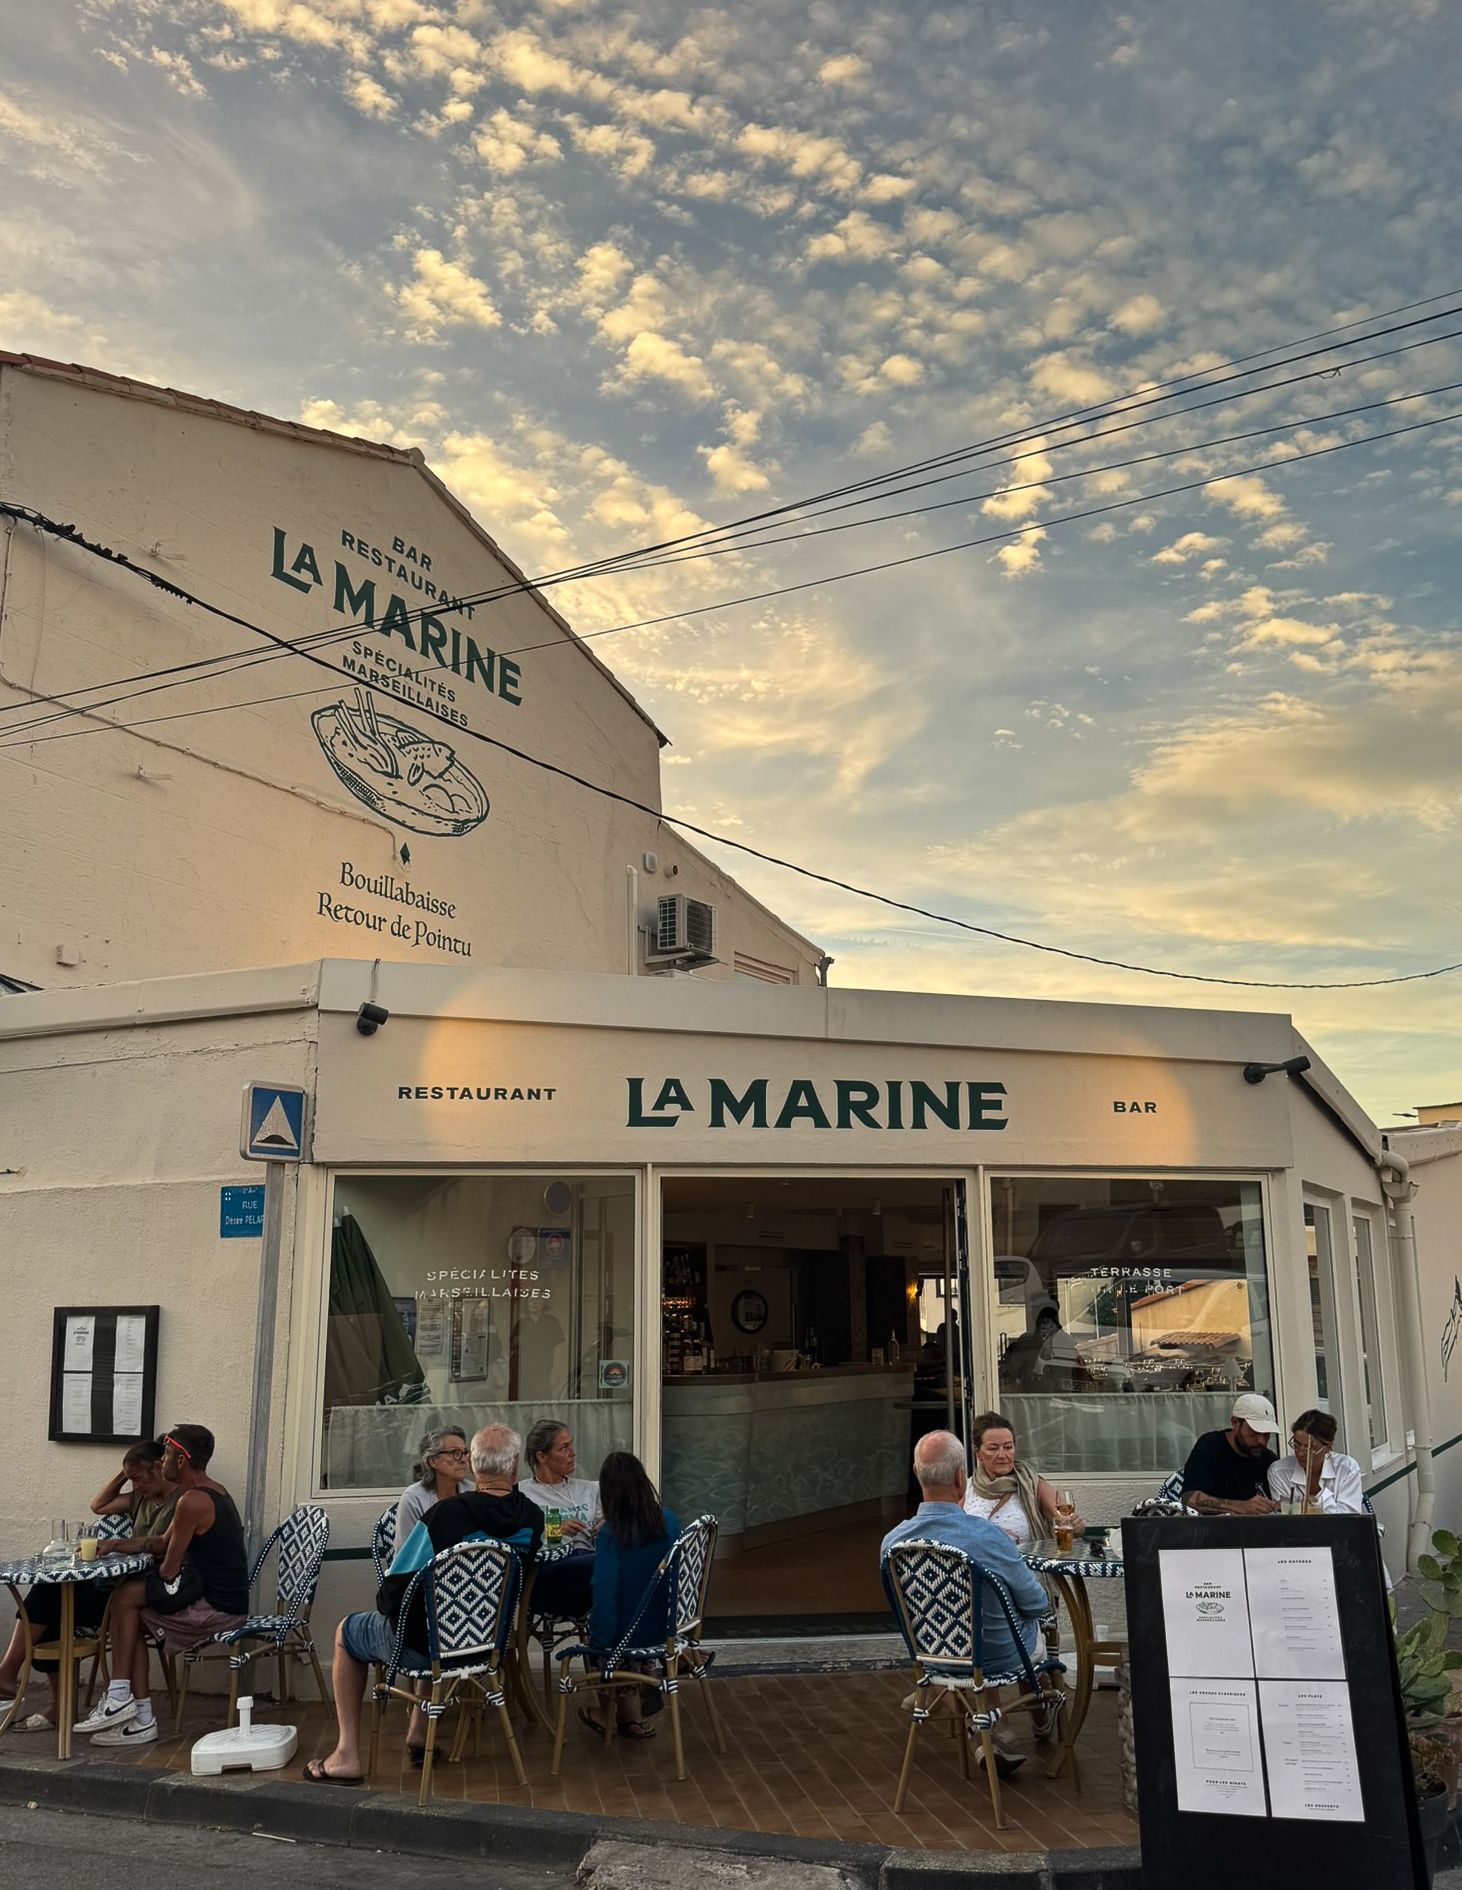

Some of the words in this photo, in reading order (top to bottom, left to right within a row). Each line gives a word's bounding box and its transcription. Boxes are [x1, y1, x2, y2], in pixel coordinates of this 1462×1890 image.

[342, 529, 475, 620] RESTAURANT
[392, 536, 432, 572] BAR
[271, 525, 323, 594] LA
[333, 559, 522, 706] MARINE
[342, 654, 469, 727] MARSEILLAISES
[352, 640, 456, 702] SPÉCIALITÉS
[339, 862, 456, 918] Bouillabaisse
[317, 891, 387, 932] Retour
[390, 914, 412, 940] de
[411, 920, 472, 957] Pointu
[398, 1087, 557, 1101] RESTAURANT
[625, 1077, 696, 1127] LA
[707, 1078, 1010, 1130] MARINE
[1112, 1100, 1158, 1113] BAR
[242, 1201, 258, 1209] RUE
[1090, 1267, 1172, 1278] TERRASSE
[1195, 1591, 1231, 1599] MARINE
